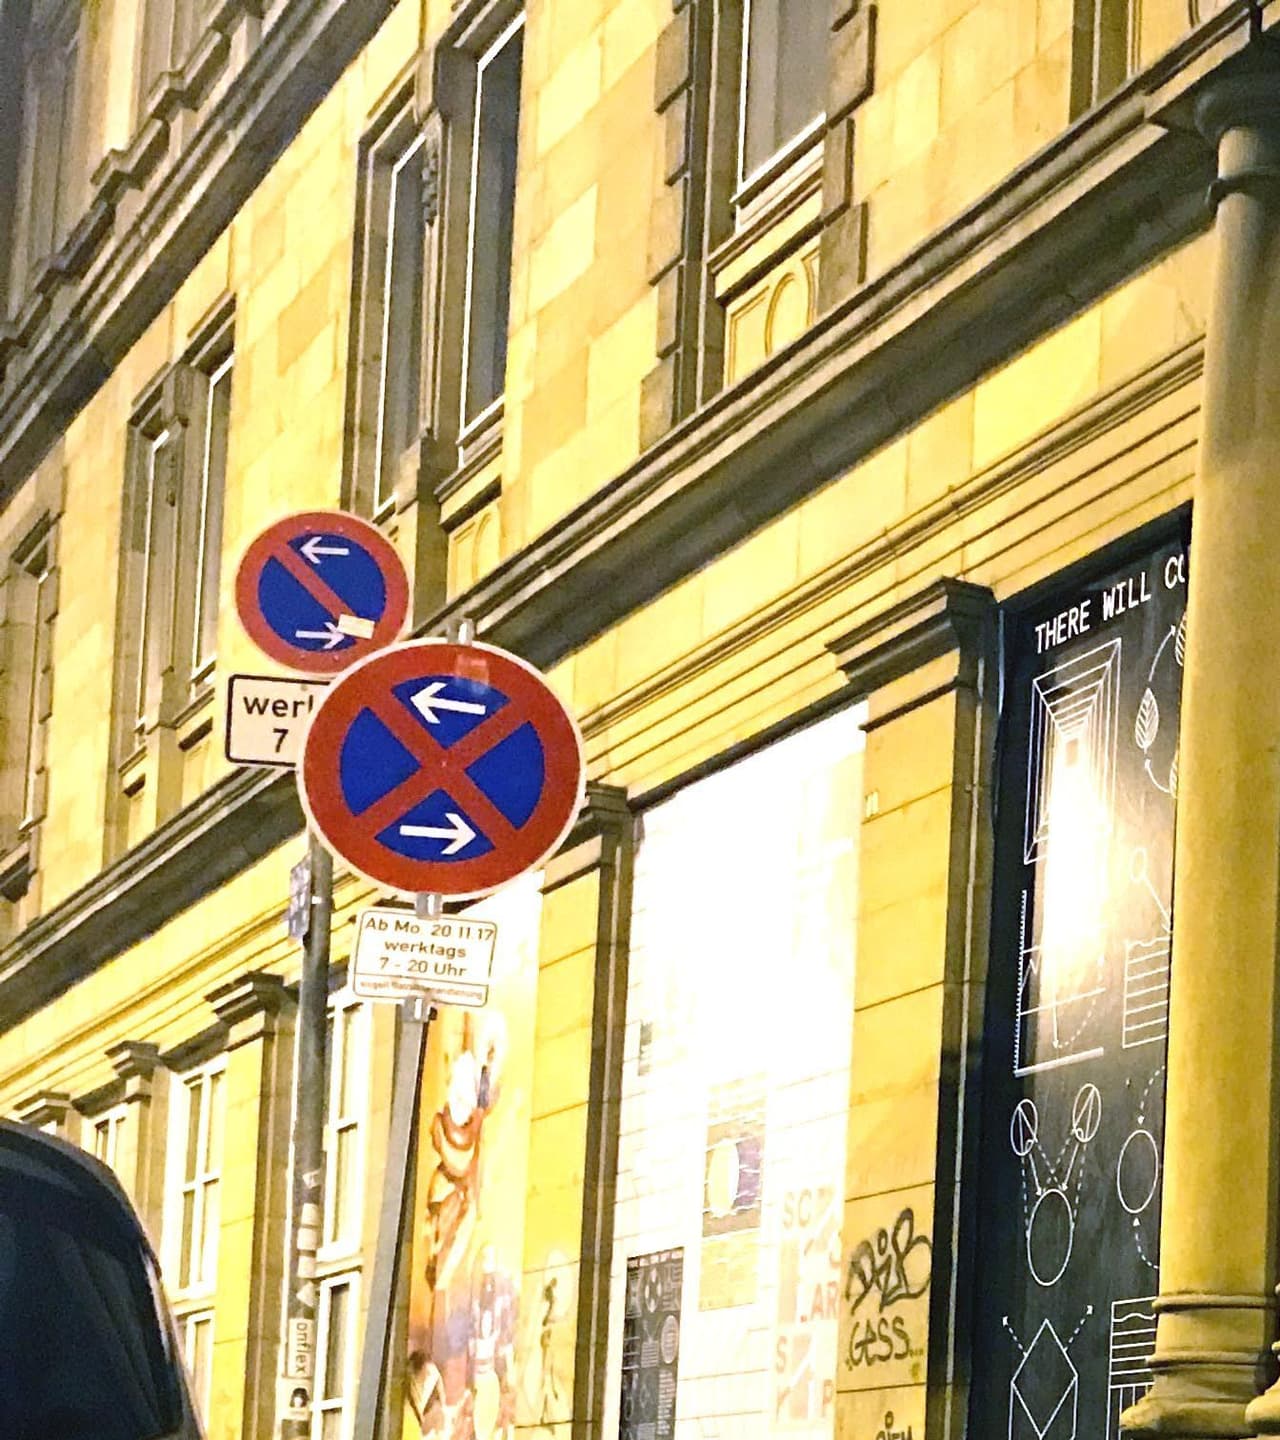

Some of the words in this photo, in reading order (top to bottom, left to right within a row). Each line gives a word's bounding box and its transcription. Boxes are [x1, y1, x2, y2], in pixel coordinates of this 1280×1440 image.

[1034, 599, 1092, 654] THERE
[1102, 571, 1152, 621] WILL
[273, 728, 289, 753] 7
[365, 917, 389, 931] Ab
[384, 941, 467, 960] werktags
[379, 957, 390, 969] 7
[407, 959, 428, 973] 20
[434, 963, 467, 977] Uhr
